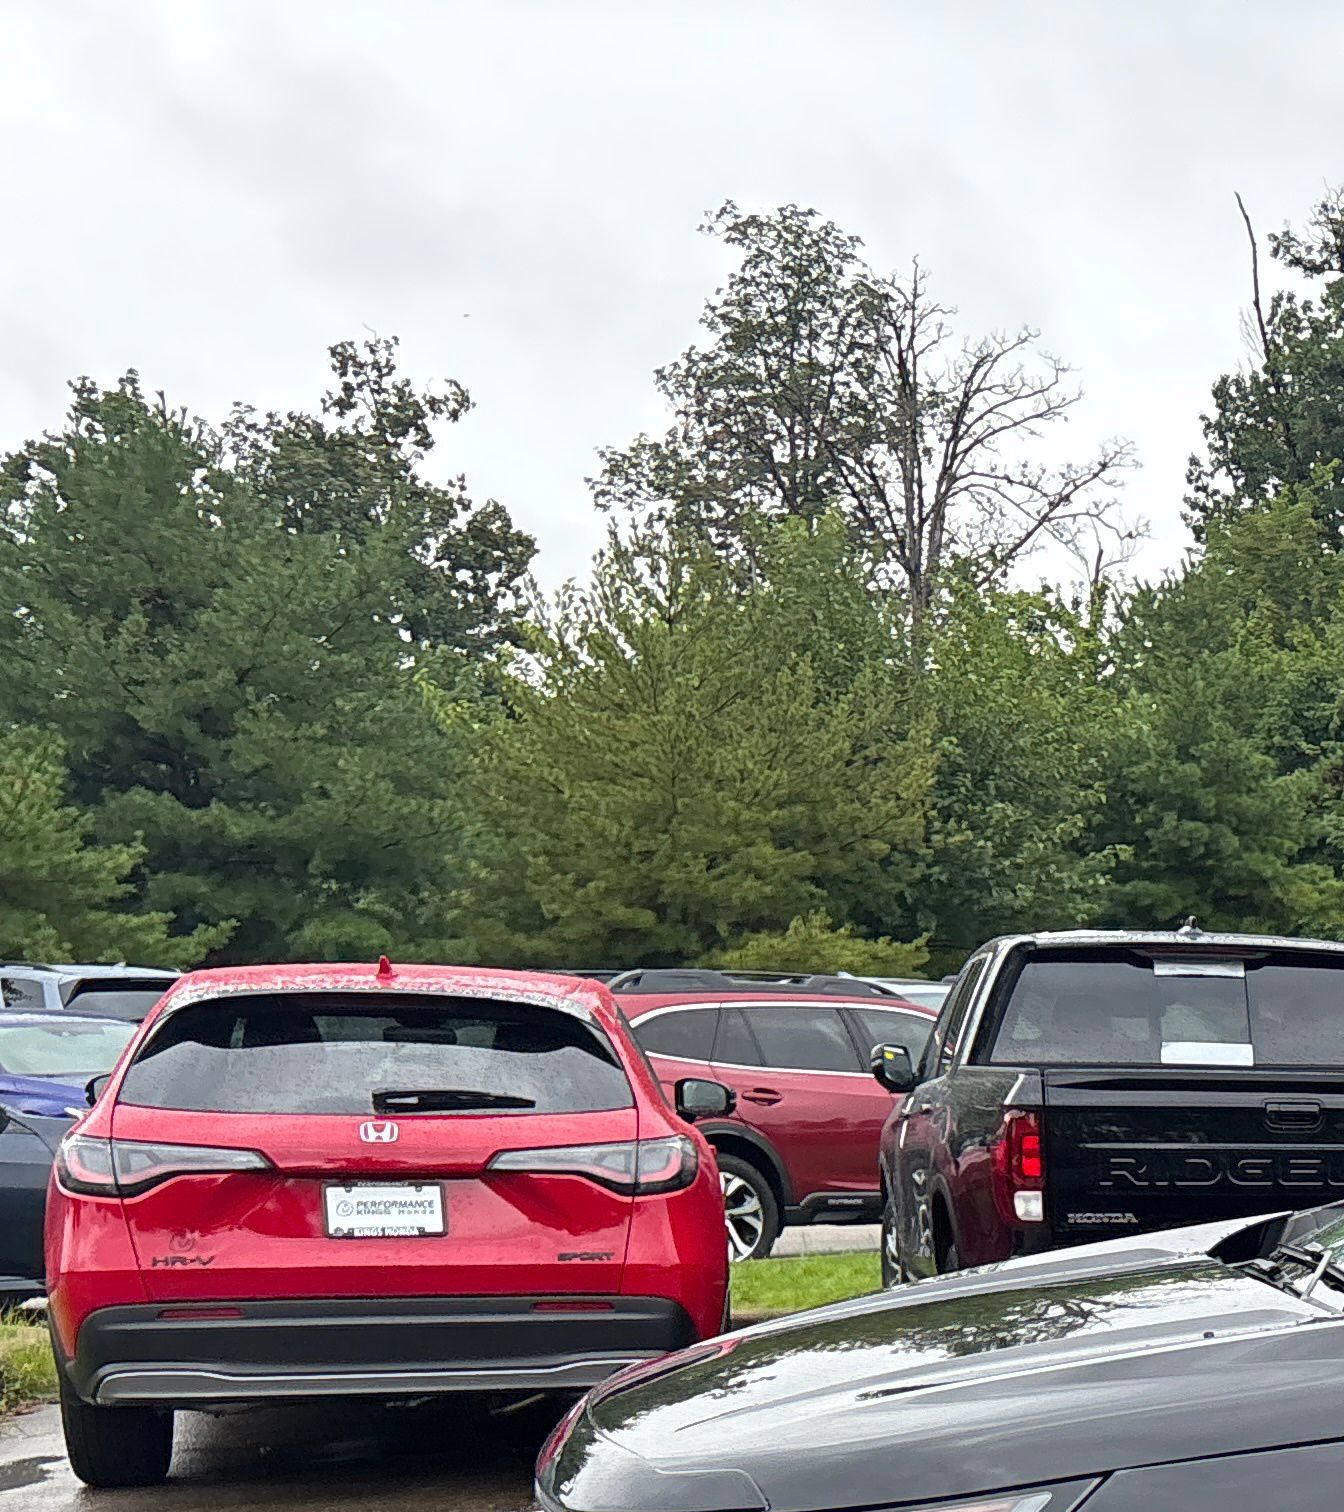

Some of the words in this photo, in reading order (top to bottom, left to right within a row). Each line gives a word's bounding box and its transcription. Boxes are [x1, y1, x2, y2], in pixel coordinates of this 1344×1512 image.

[356, 1199, 435, 1209] PERFORMANCE
[1067, 1212, 1139, 1224] HONDA
[151, 1255, 215, 1267] HR-V
